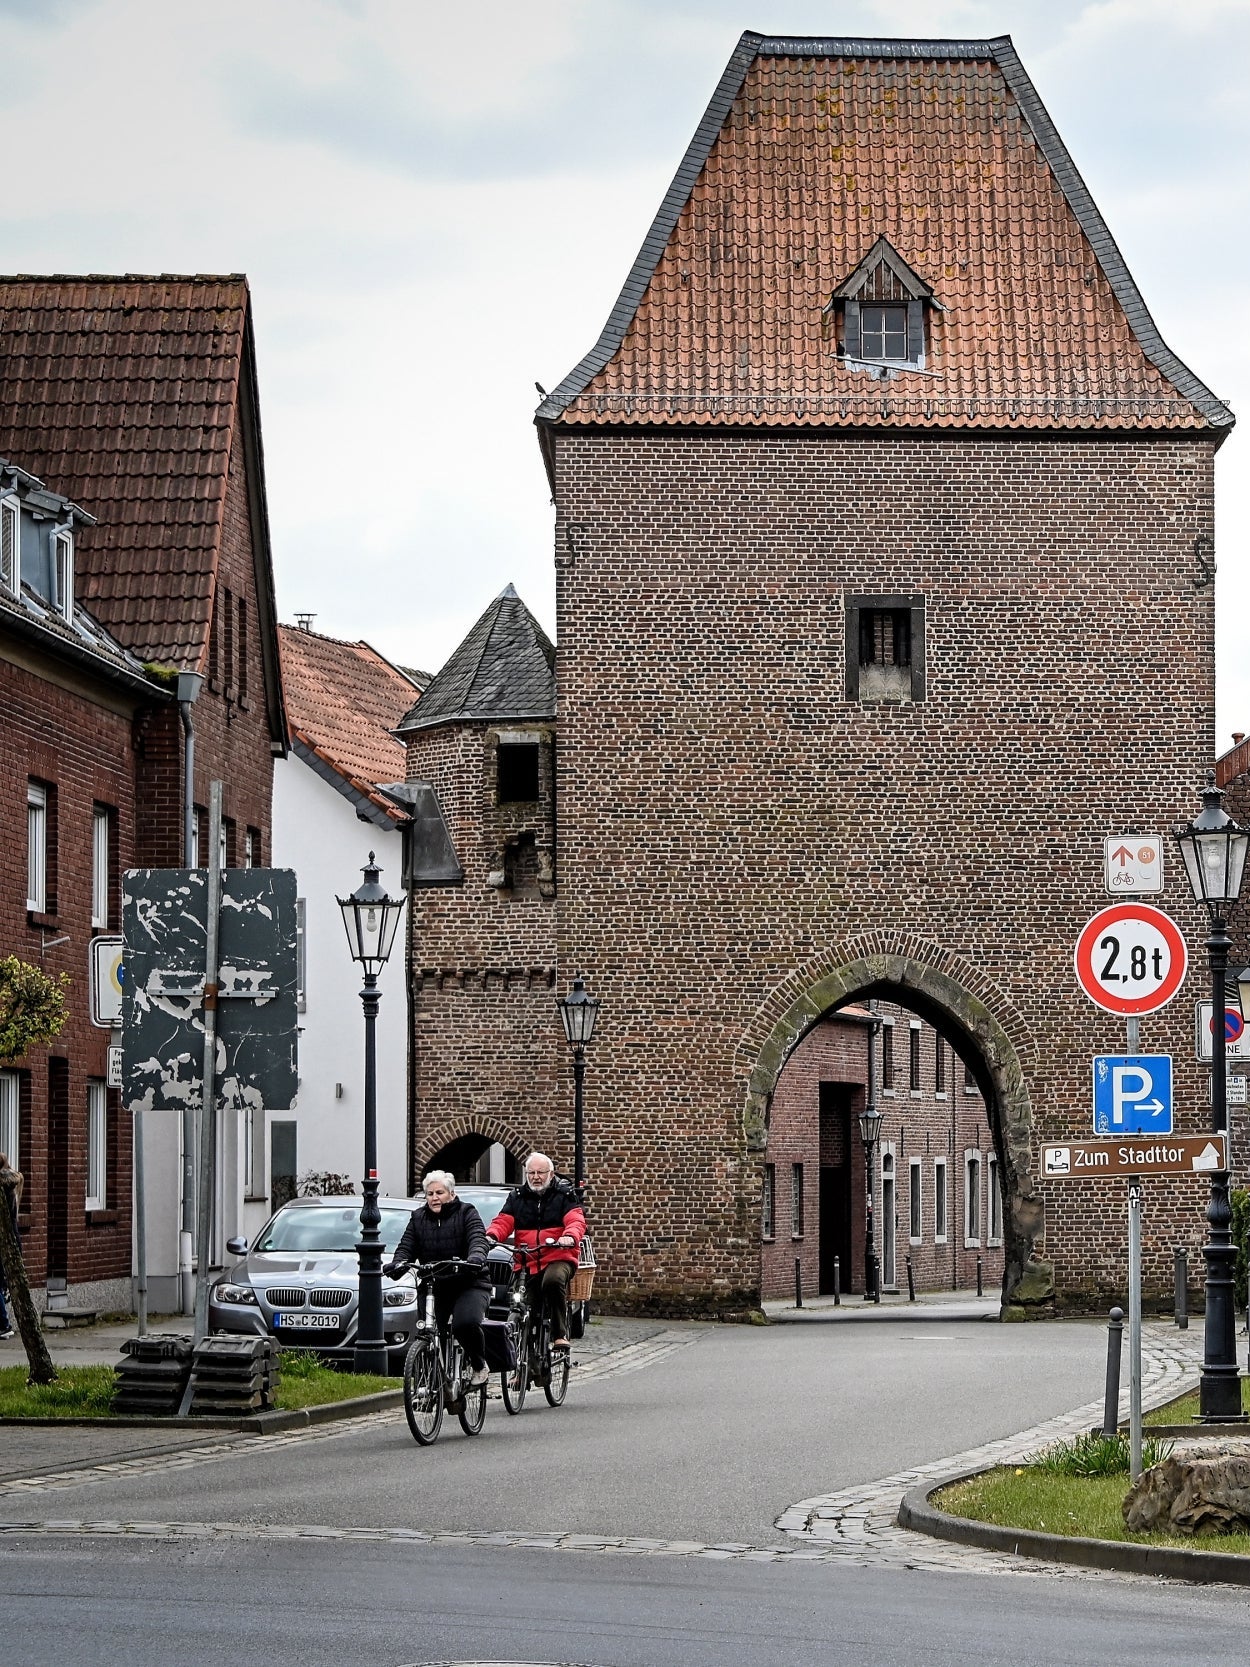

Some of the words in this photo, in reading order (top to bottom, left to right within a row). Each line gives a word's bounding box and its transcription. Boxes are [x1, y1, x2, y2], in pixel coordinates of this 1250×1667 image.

[1227, 1045, 1240, 1053] NE
[1112, 1066, 1153, 1124] P
[1074, 1149, 1109, 1166] Zum
[1118, 1145, 1185, 1165] Stadttor
[280, 1315, 295, 1325] HS
[301, 1315, 308, 1326] C
[311, 1316, 338, 1327] 2019
